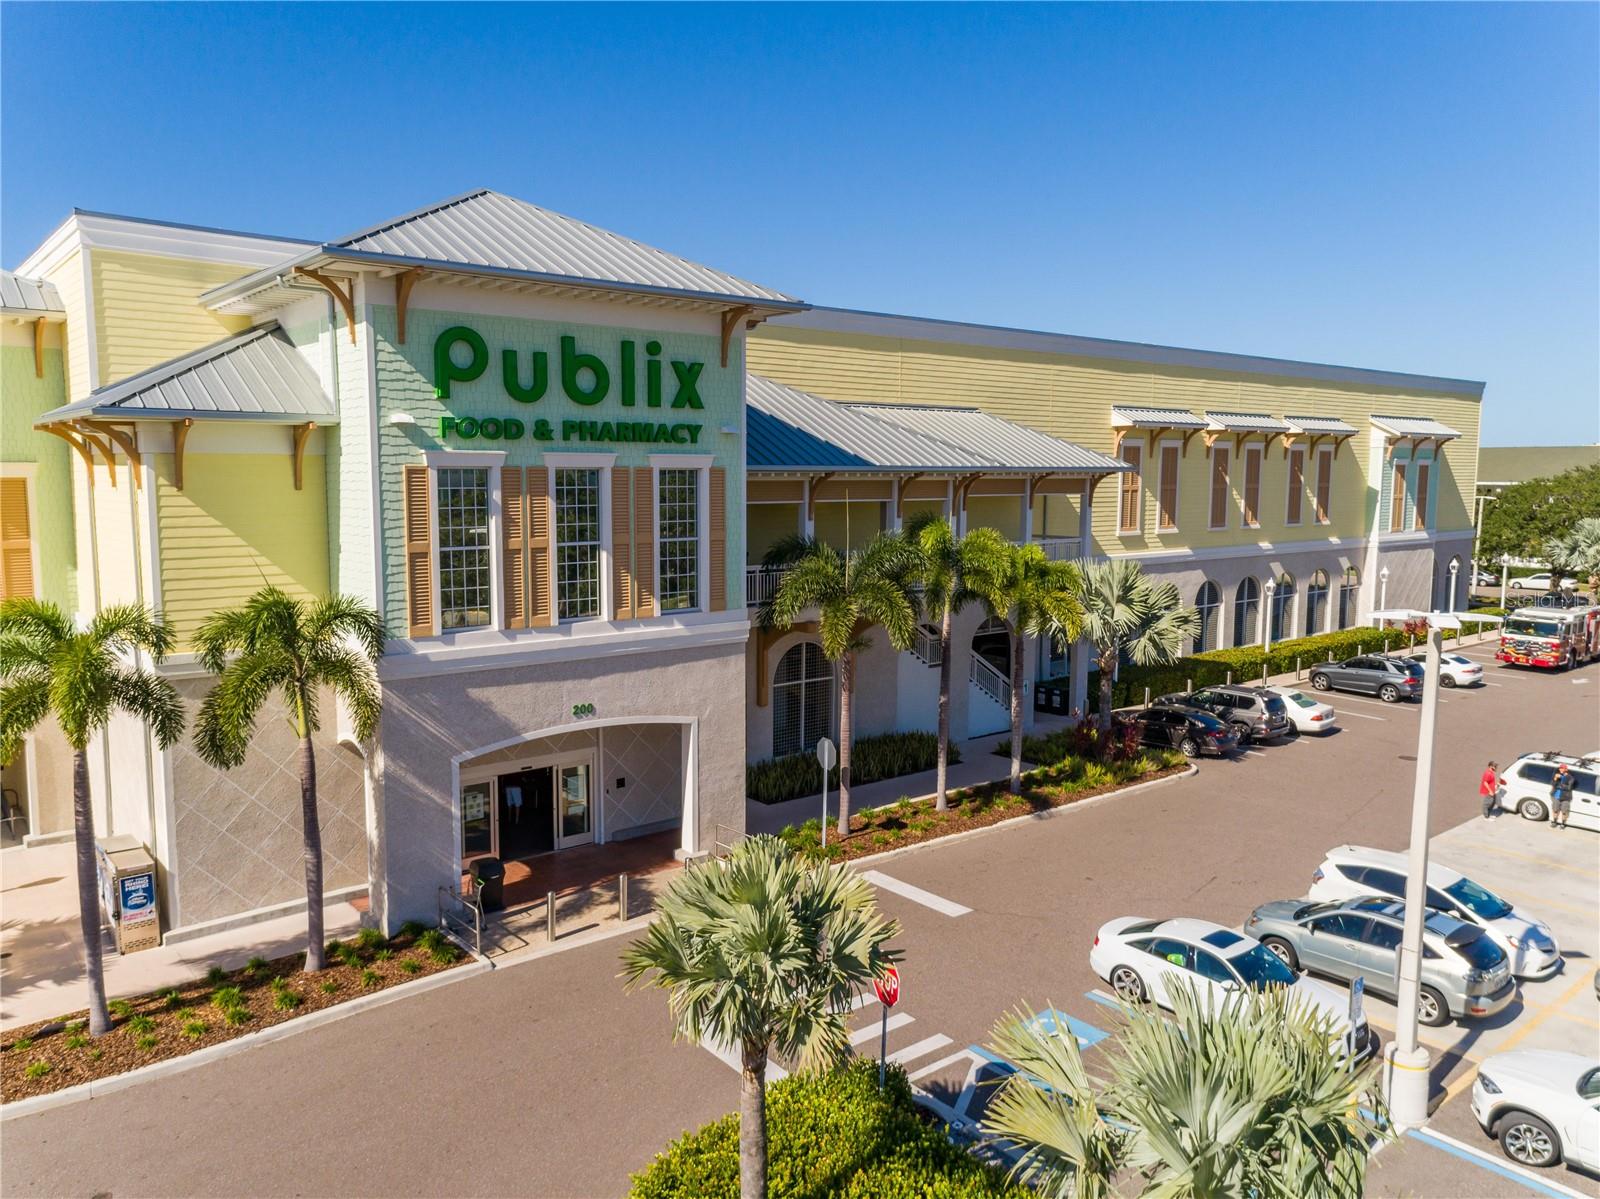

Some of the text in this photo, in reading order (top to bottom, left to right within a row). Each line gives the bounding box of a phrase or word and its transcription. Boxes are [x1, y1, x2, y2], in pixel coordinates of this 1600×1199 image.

[434, 325, 704, 409] Publix
[439, 416, 703, 444] FOOD & PHARMACY
[572, 703, 593, 715] 200
